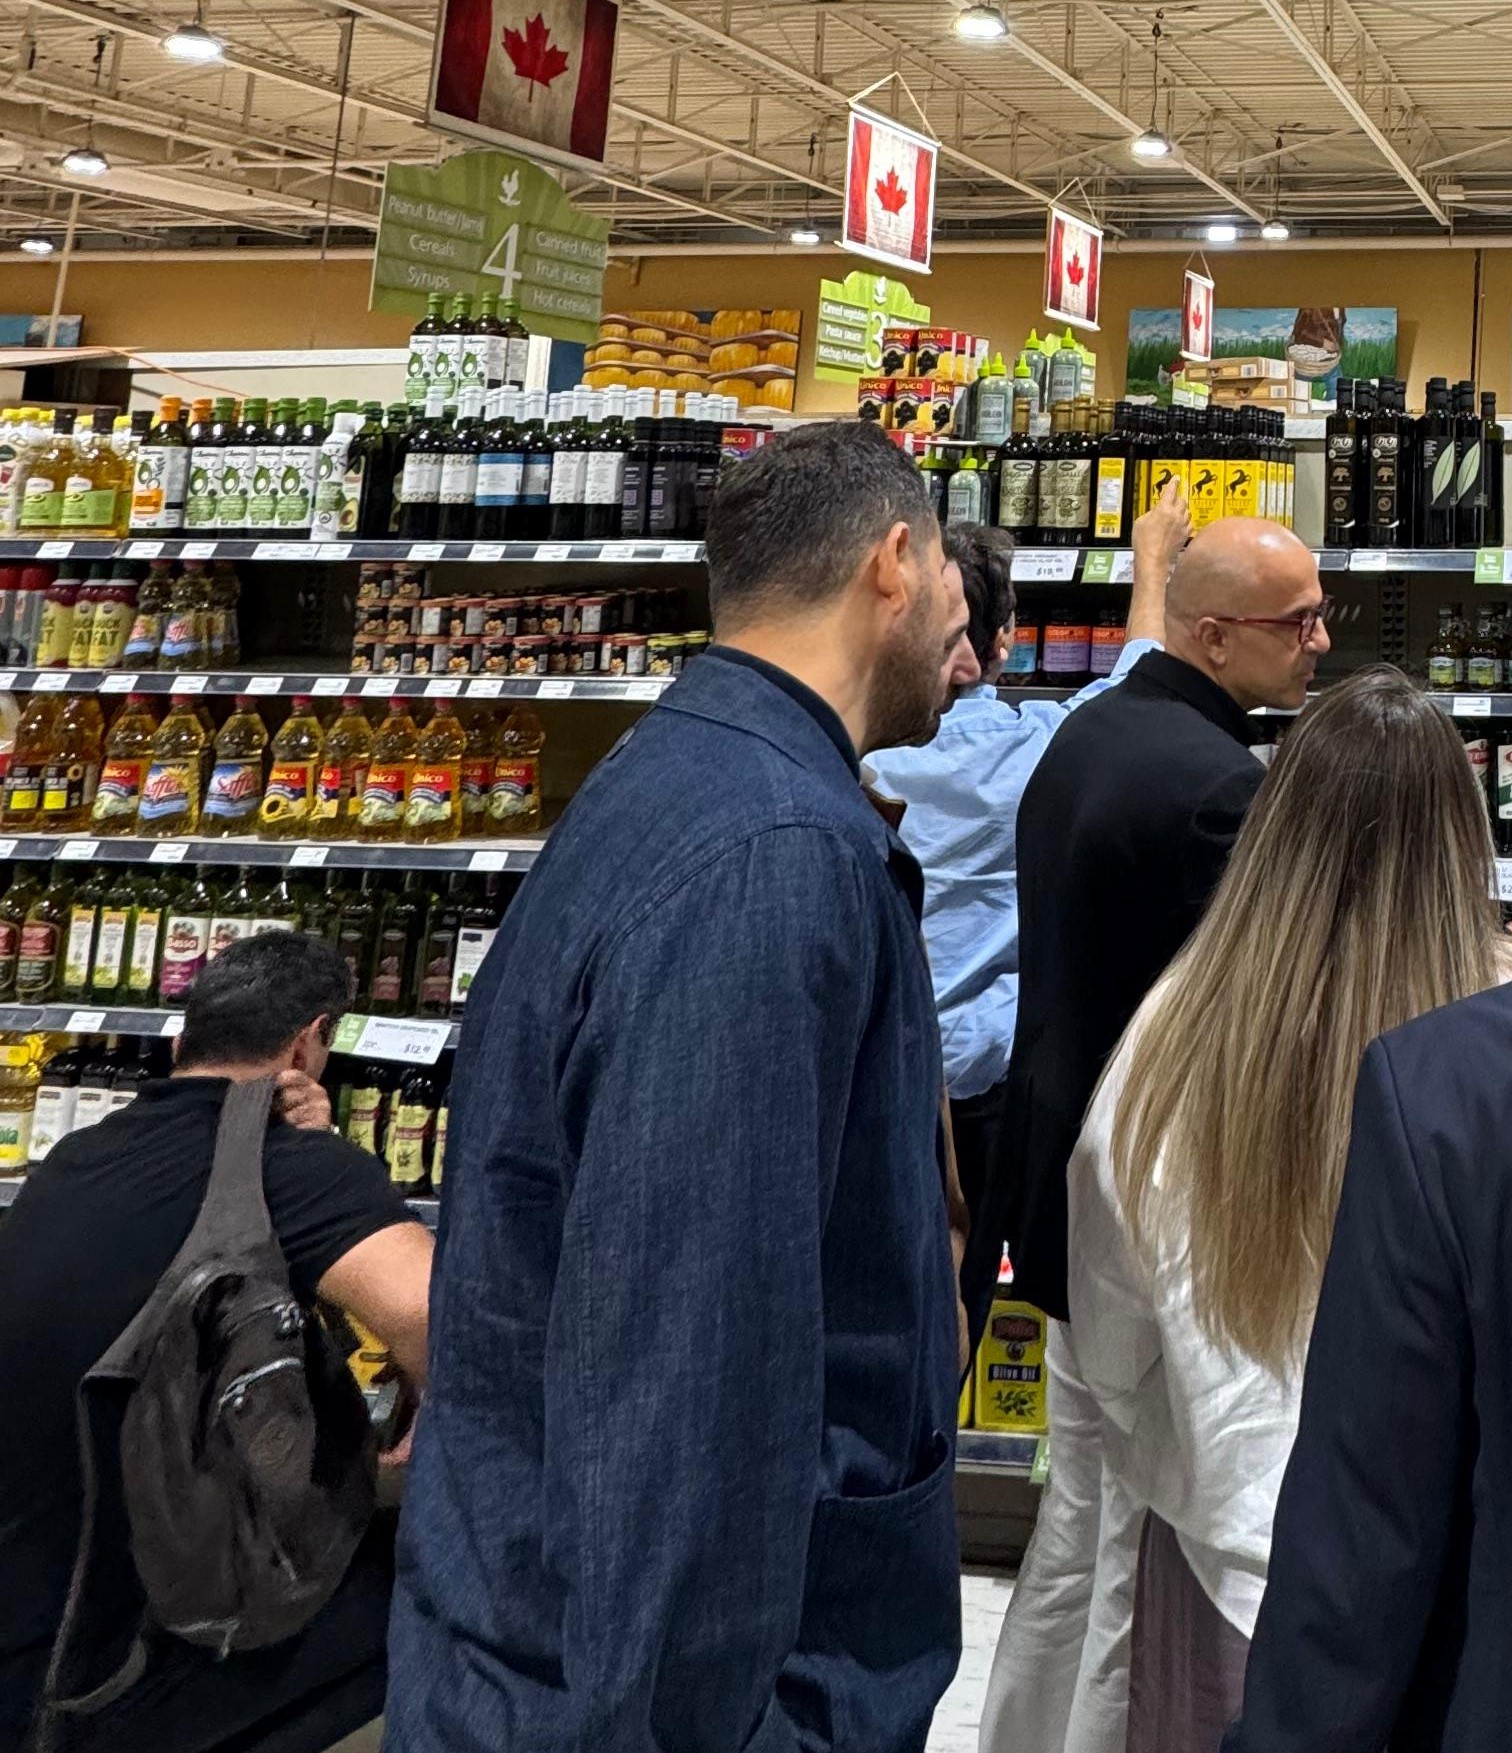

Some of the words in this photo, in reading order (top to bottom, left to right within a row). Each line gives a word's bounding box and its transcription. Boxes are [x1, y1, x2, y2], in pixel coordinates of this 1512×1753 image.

[388, 194, 424, 218] Peanut
[409, 233, 455, 257] Cereals
[535, 231, 579, 252] Canned
[480, 222, 523, 298] 4
[407, 265, 450, 289] Syrups
[533, 289, 554, 305] Hot
[866, 311, 889, 369] 3
[993, 1365, 1018, 1380] Olive
[1021, 1366, 1037, 1381] Oil
